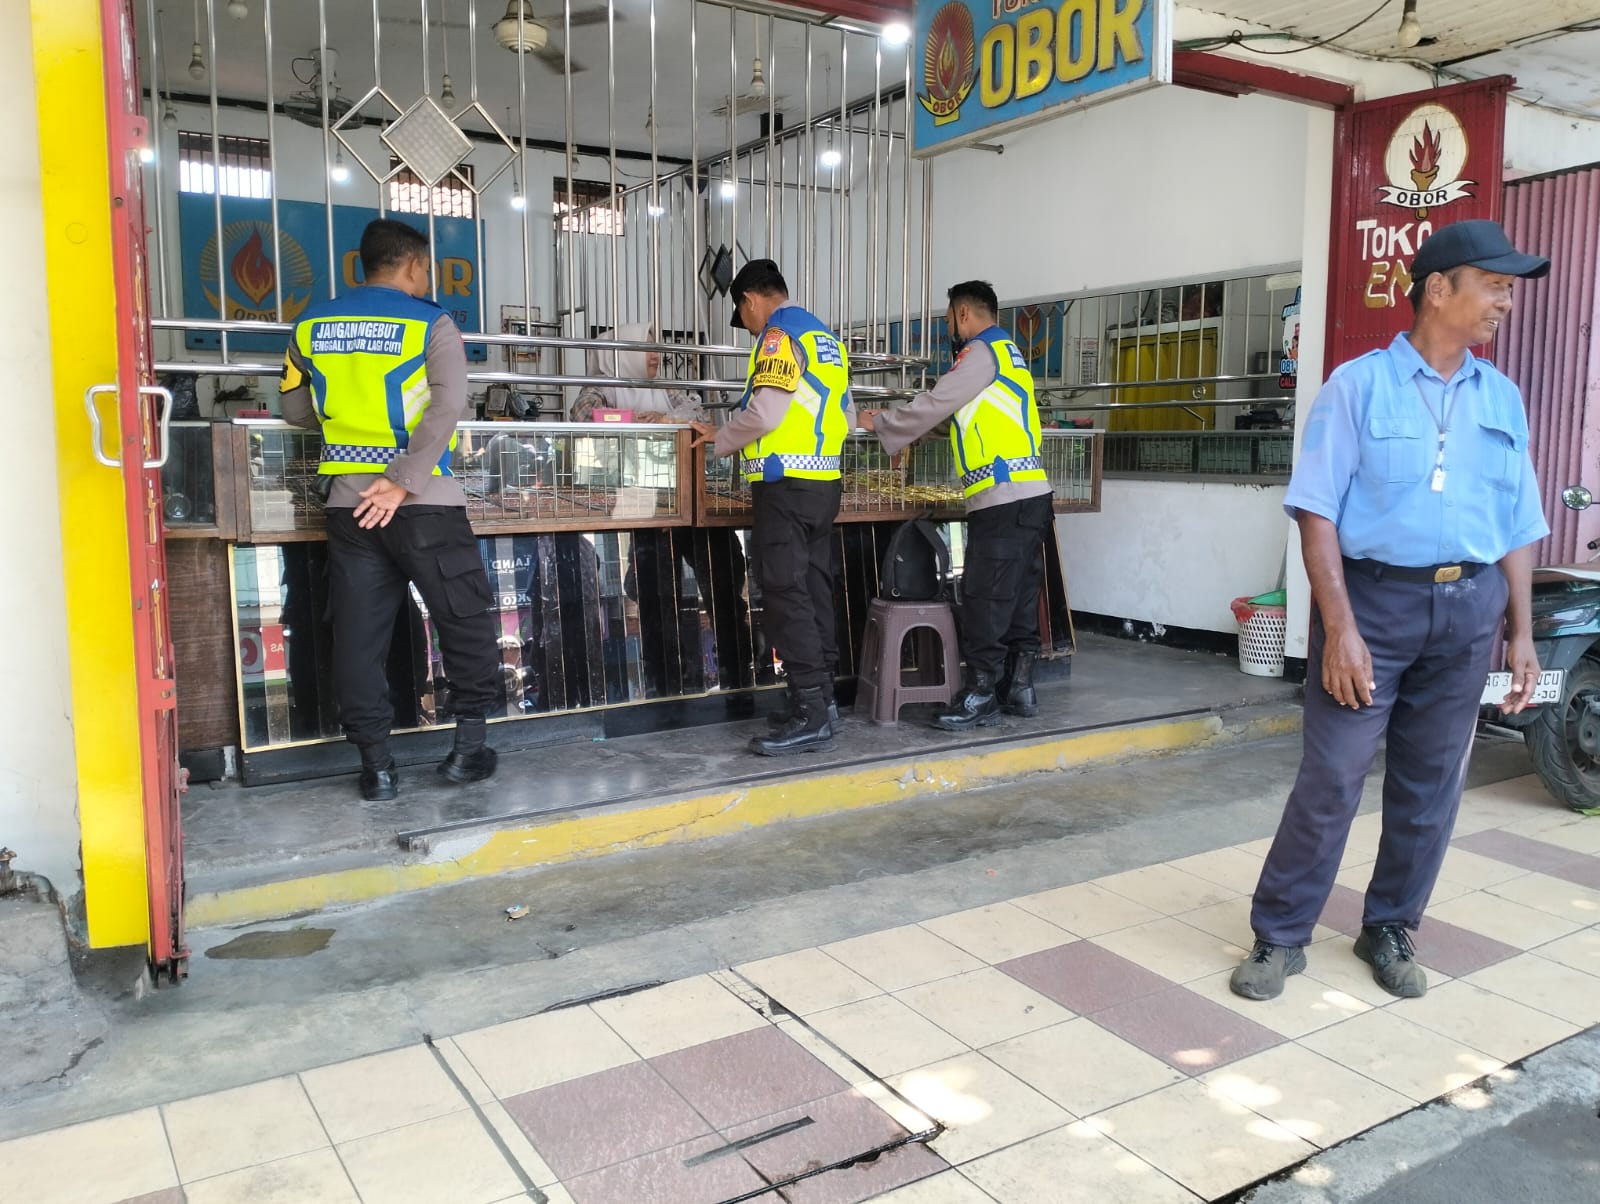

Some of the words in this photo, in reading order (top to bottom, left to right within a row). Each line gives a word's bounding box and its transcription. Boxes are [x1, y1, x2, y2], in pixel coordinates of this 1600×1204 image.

[980, 0, 1144, 109] OBOR
[932, 93, 962, 113] OBOR
[1397, 190, 1448, 206] OBOR
[317, 322, 358, 339] JANGAN
[359, 321, 400, 339] NGEBUT
